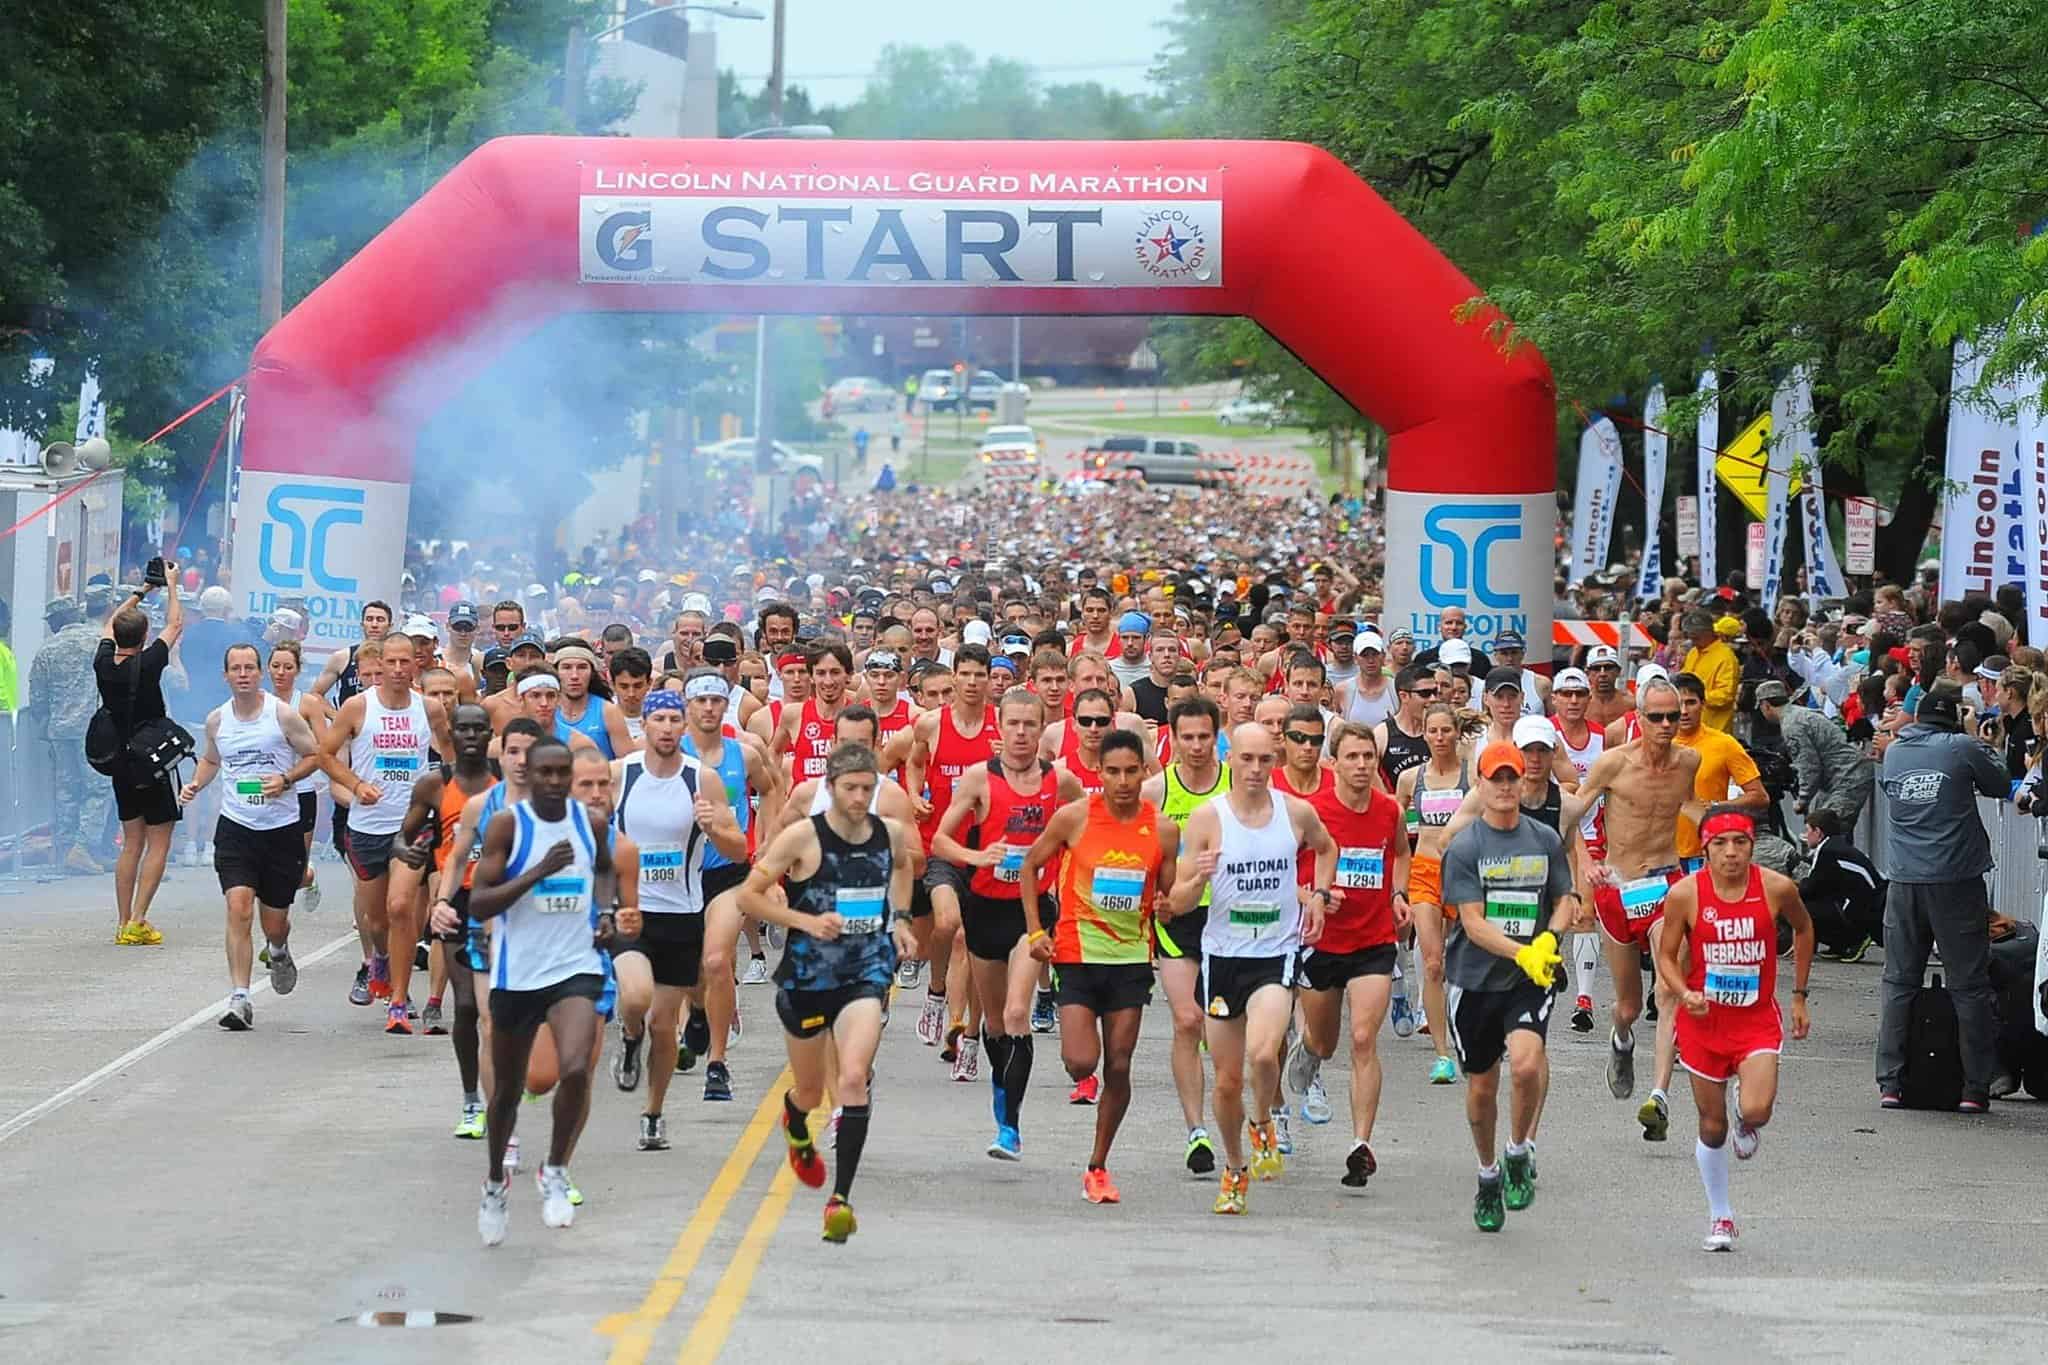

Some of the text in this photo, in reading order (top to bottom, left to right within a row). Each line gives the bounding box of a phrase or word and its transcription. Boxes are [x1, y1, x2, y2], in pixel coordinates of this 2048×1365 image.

[596, 169, 1208, 194] LINCOLN NATIONAL GUARD MARATHON
[1137, 205, 1203, 237] LINCOLN
[700, 205, 1103, 281] START
[1136, 246, 1206, 278] MARATHON
[1584, 488, 1602, 565] Lincoln
[1965, 449, 2001, 600] Lincoln
[249, 591, 361, 619] LIOLN
[315, 622, 361, 639] CLUB
[381, 716, 410, 731] TEAM
[373, 734, 418, 749] NEBRASKA
[812, 739, 832, 757] TEA
[803, 758, 827, 774] NEBR
[939, 764, 960, 776] TEAM
[383, 770, 410, 781] 2060
[643, 853, 674, 866] Mark
[1227, 857, 1288, 875] NATIONAL
[644, 868, 674, 881] 1309
[1347, 874, 1376, 887] 1294
[1236, 877, 1280, 891] GUARD
[546, 896, 579, 911] 1447
[1101, 895, 1132, 910] 4650
[1498, 903, 1529, 917] Brien
[1503, 921, 1520, 934] 43
[1714, 917, 1755, 941] TEAM
[1702, 940, 1766, 963] NEBRASKA
[1715, 974, 1750, 992] Ricky
[1715, 992, 1748, 1005] 1287
